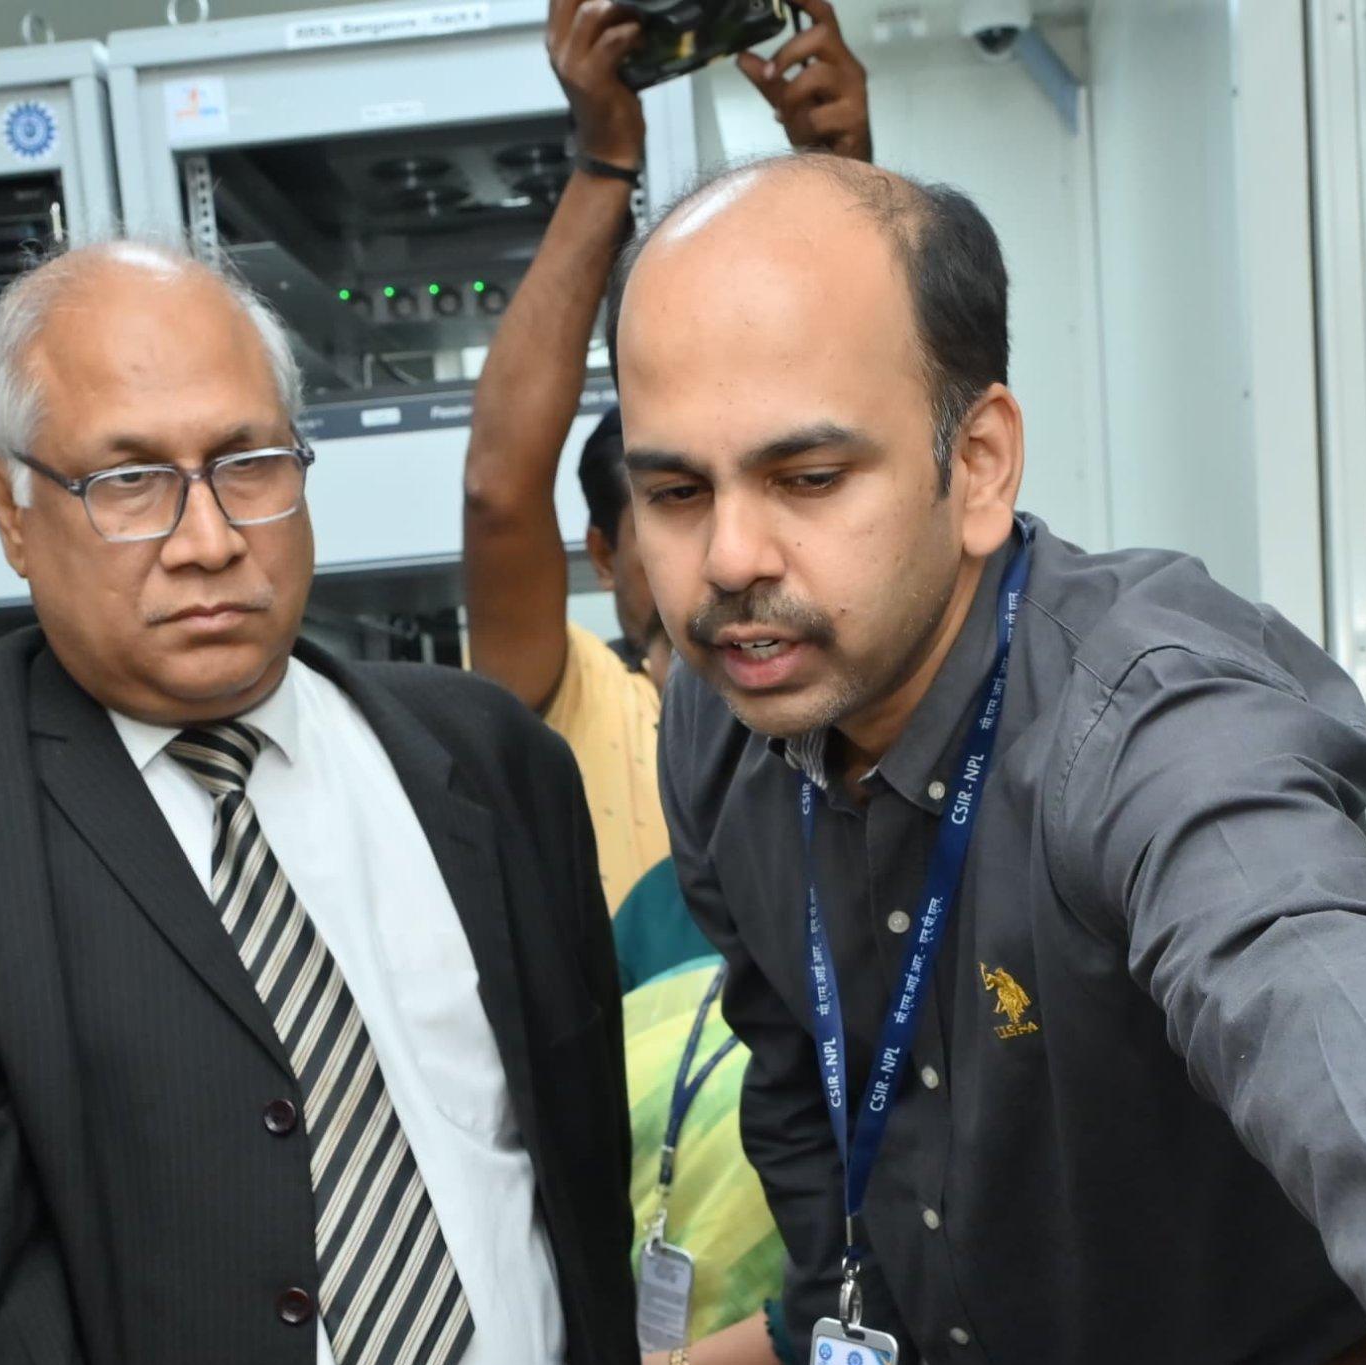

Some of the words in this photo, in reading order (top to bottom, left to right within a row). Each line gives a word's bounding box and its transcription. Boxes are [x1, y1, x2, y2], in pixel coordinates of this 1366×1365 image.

[950, 790, 973, 825] CSIR
[962, 752, 985, 783] NPL
[822, 1036, 838, 1067] NPL
[828, 1078, 843, 1109] CSIR
[869, 1082, 889, 1112] CSIR
[880, 1045, 901, 1074] NPL
